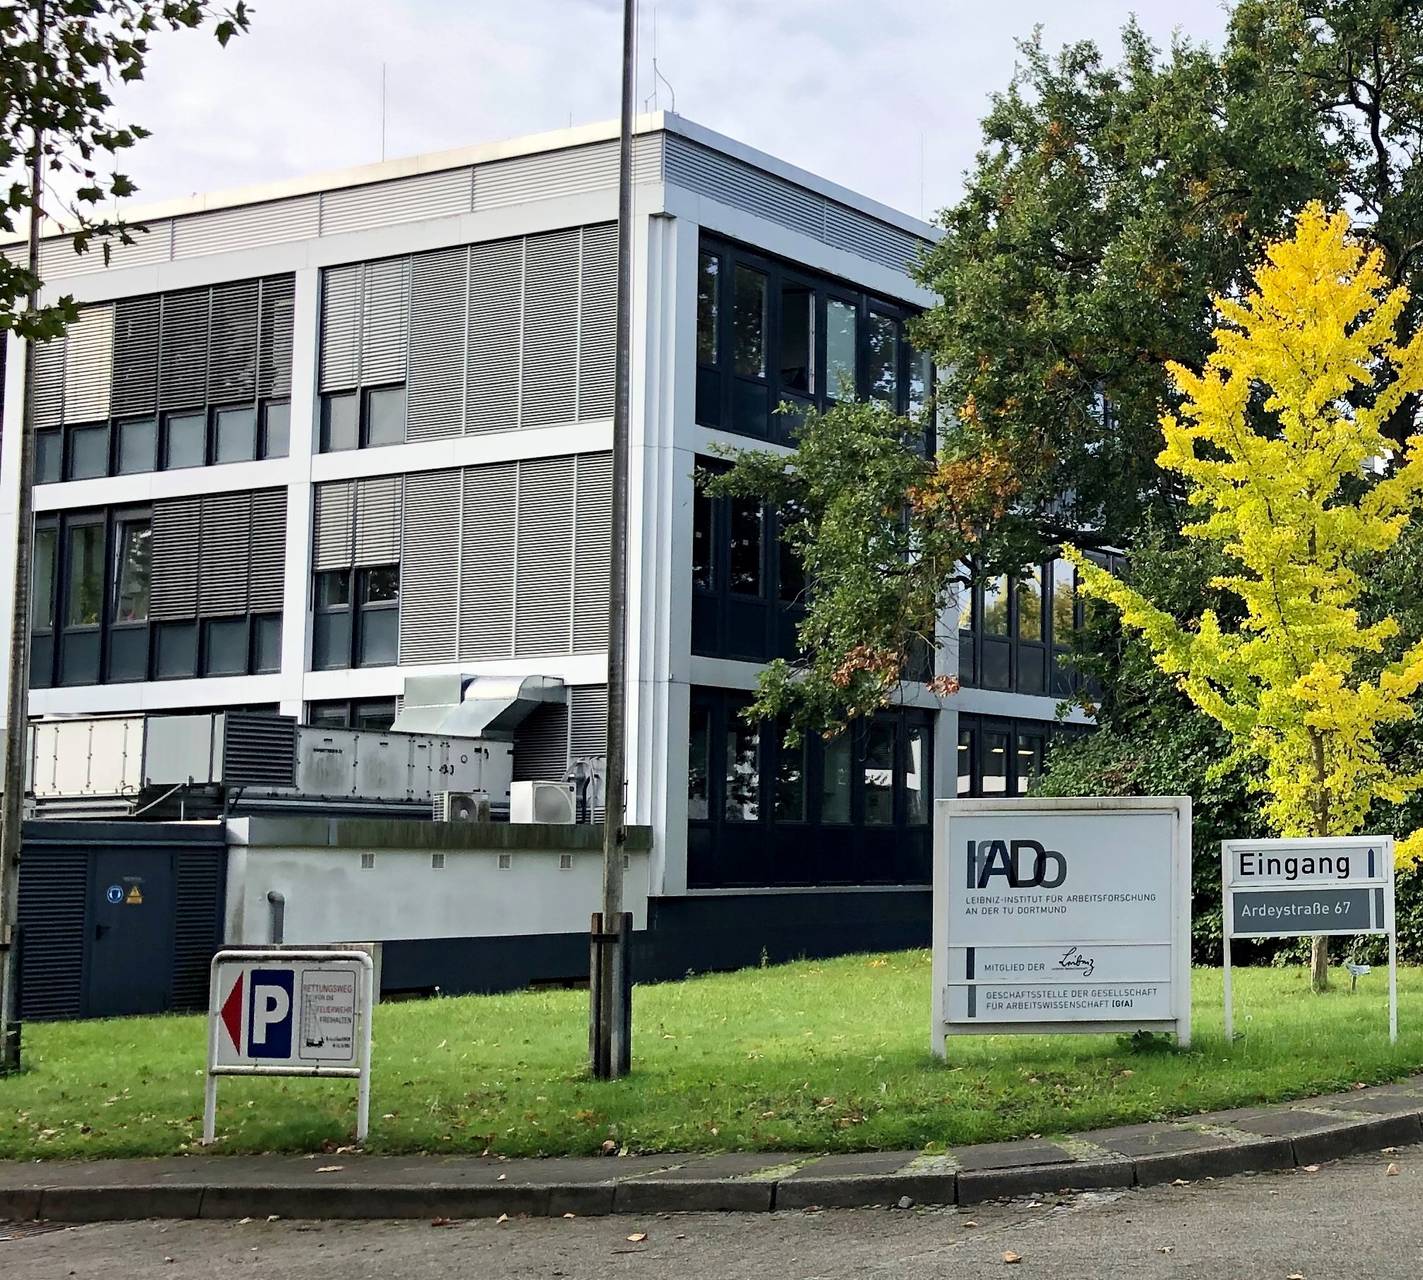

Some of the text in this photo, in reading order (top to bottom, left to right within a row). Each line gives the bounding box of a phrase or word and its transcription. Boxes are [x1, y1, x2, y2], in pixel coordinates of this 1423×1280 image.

[1239, 852, 1351, 881] Eingang
[965, 895, 1043, 905] LEIBNIZ-INSTITUT
[1066, 893, 1157, 903] ARBEITSFORSCHUNG
[965, 905, 1067, 915] AN DER TU DORTMUND
[1241, 901, 1351, 919] Ardeystraße 67
[984, 963, 1026, 972] MITGLIED
[1027, 963, 1046, 971] DER
[303, 984, 353, 994] RETTUNGSWEG
[1071, 989, 1089, 998] DER
[1091, 988, 1158, 998] GESELLSCHAFT
[1006, 1000, 1110, 1010] ARBEITSWISSENSCHAFT
[252, 985, 290, 1045] P
